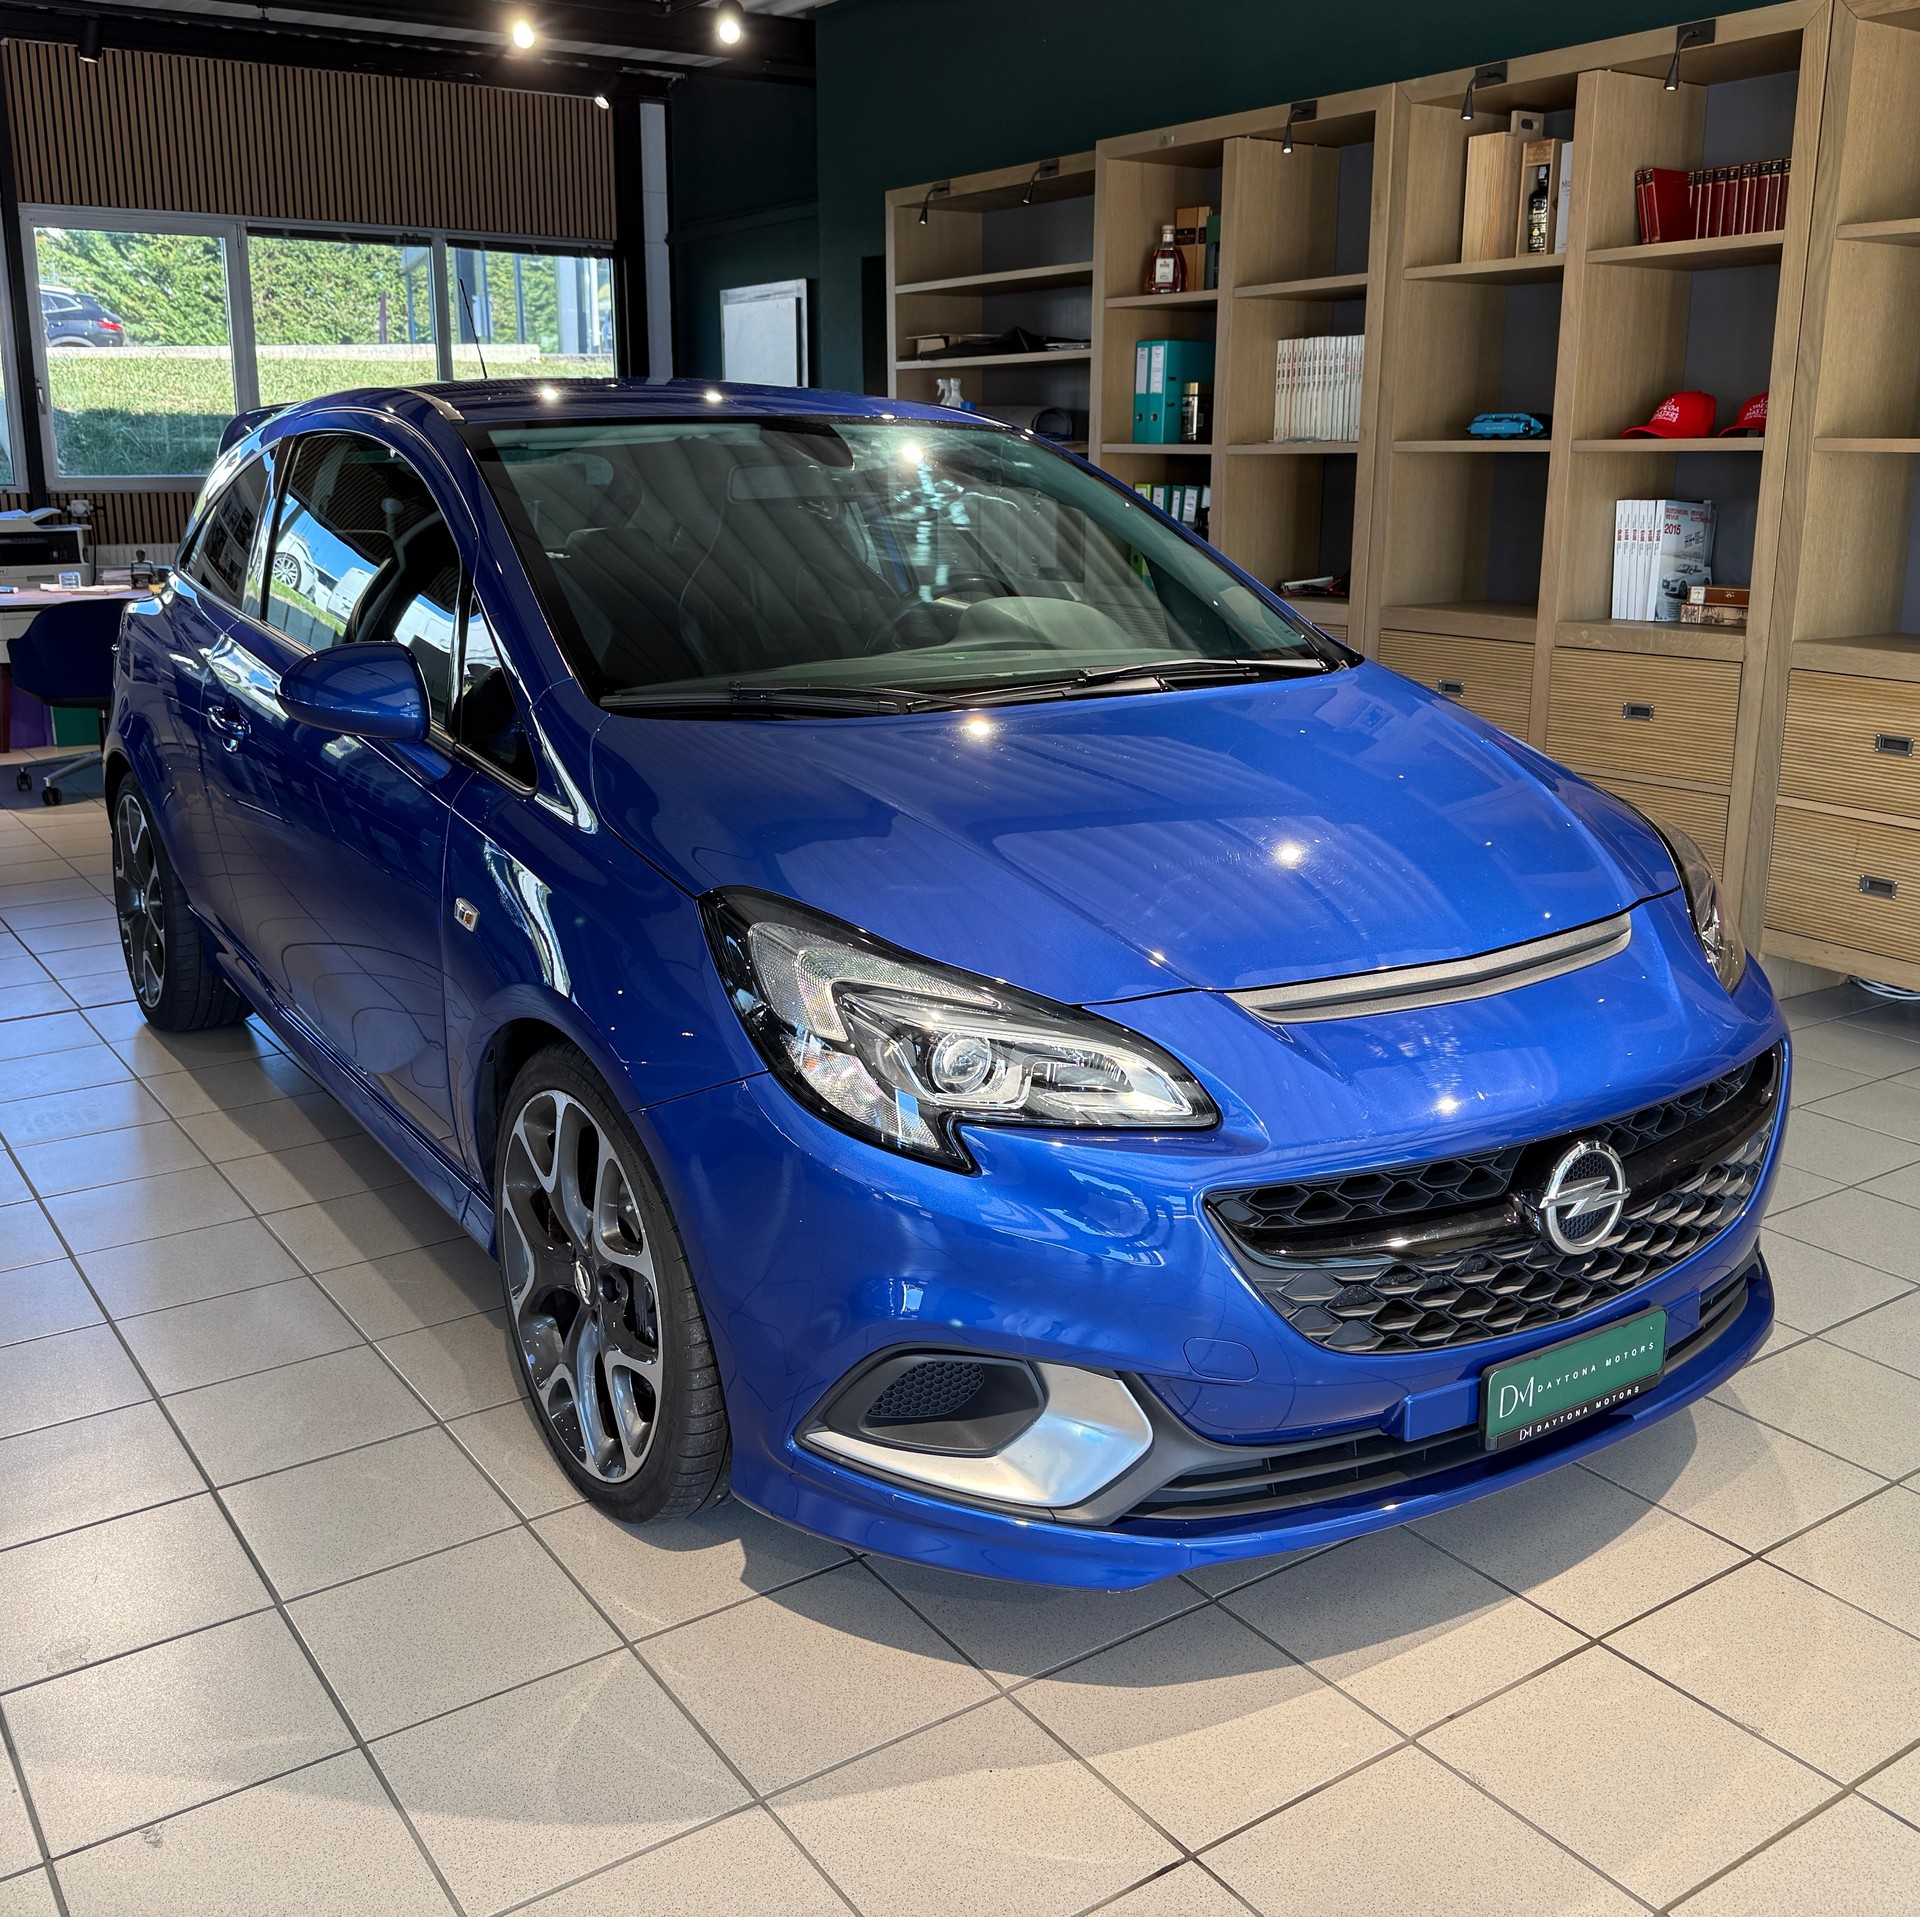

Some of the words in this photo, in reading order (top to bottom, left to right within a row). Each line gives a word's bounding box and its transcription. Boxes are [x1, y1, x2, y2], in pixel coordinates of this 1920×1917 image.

[1663, 523, 1681, 536] 2015
[1537, 1364, 1597, 1393] DAYTONA
[1605, 1341, 1655, 1367] MOTORS
[1536, 1406, 1589, 1433] DAYTONA
[1595, 1385, 1640, 1409] MOTORS
